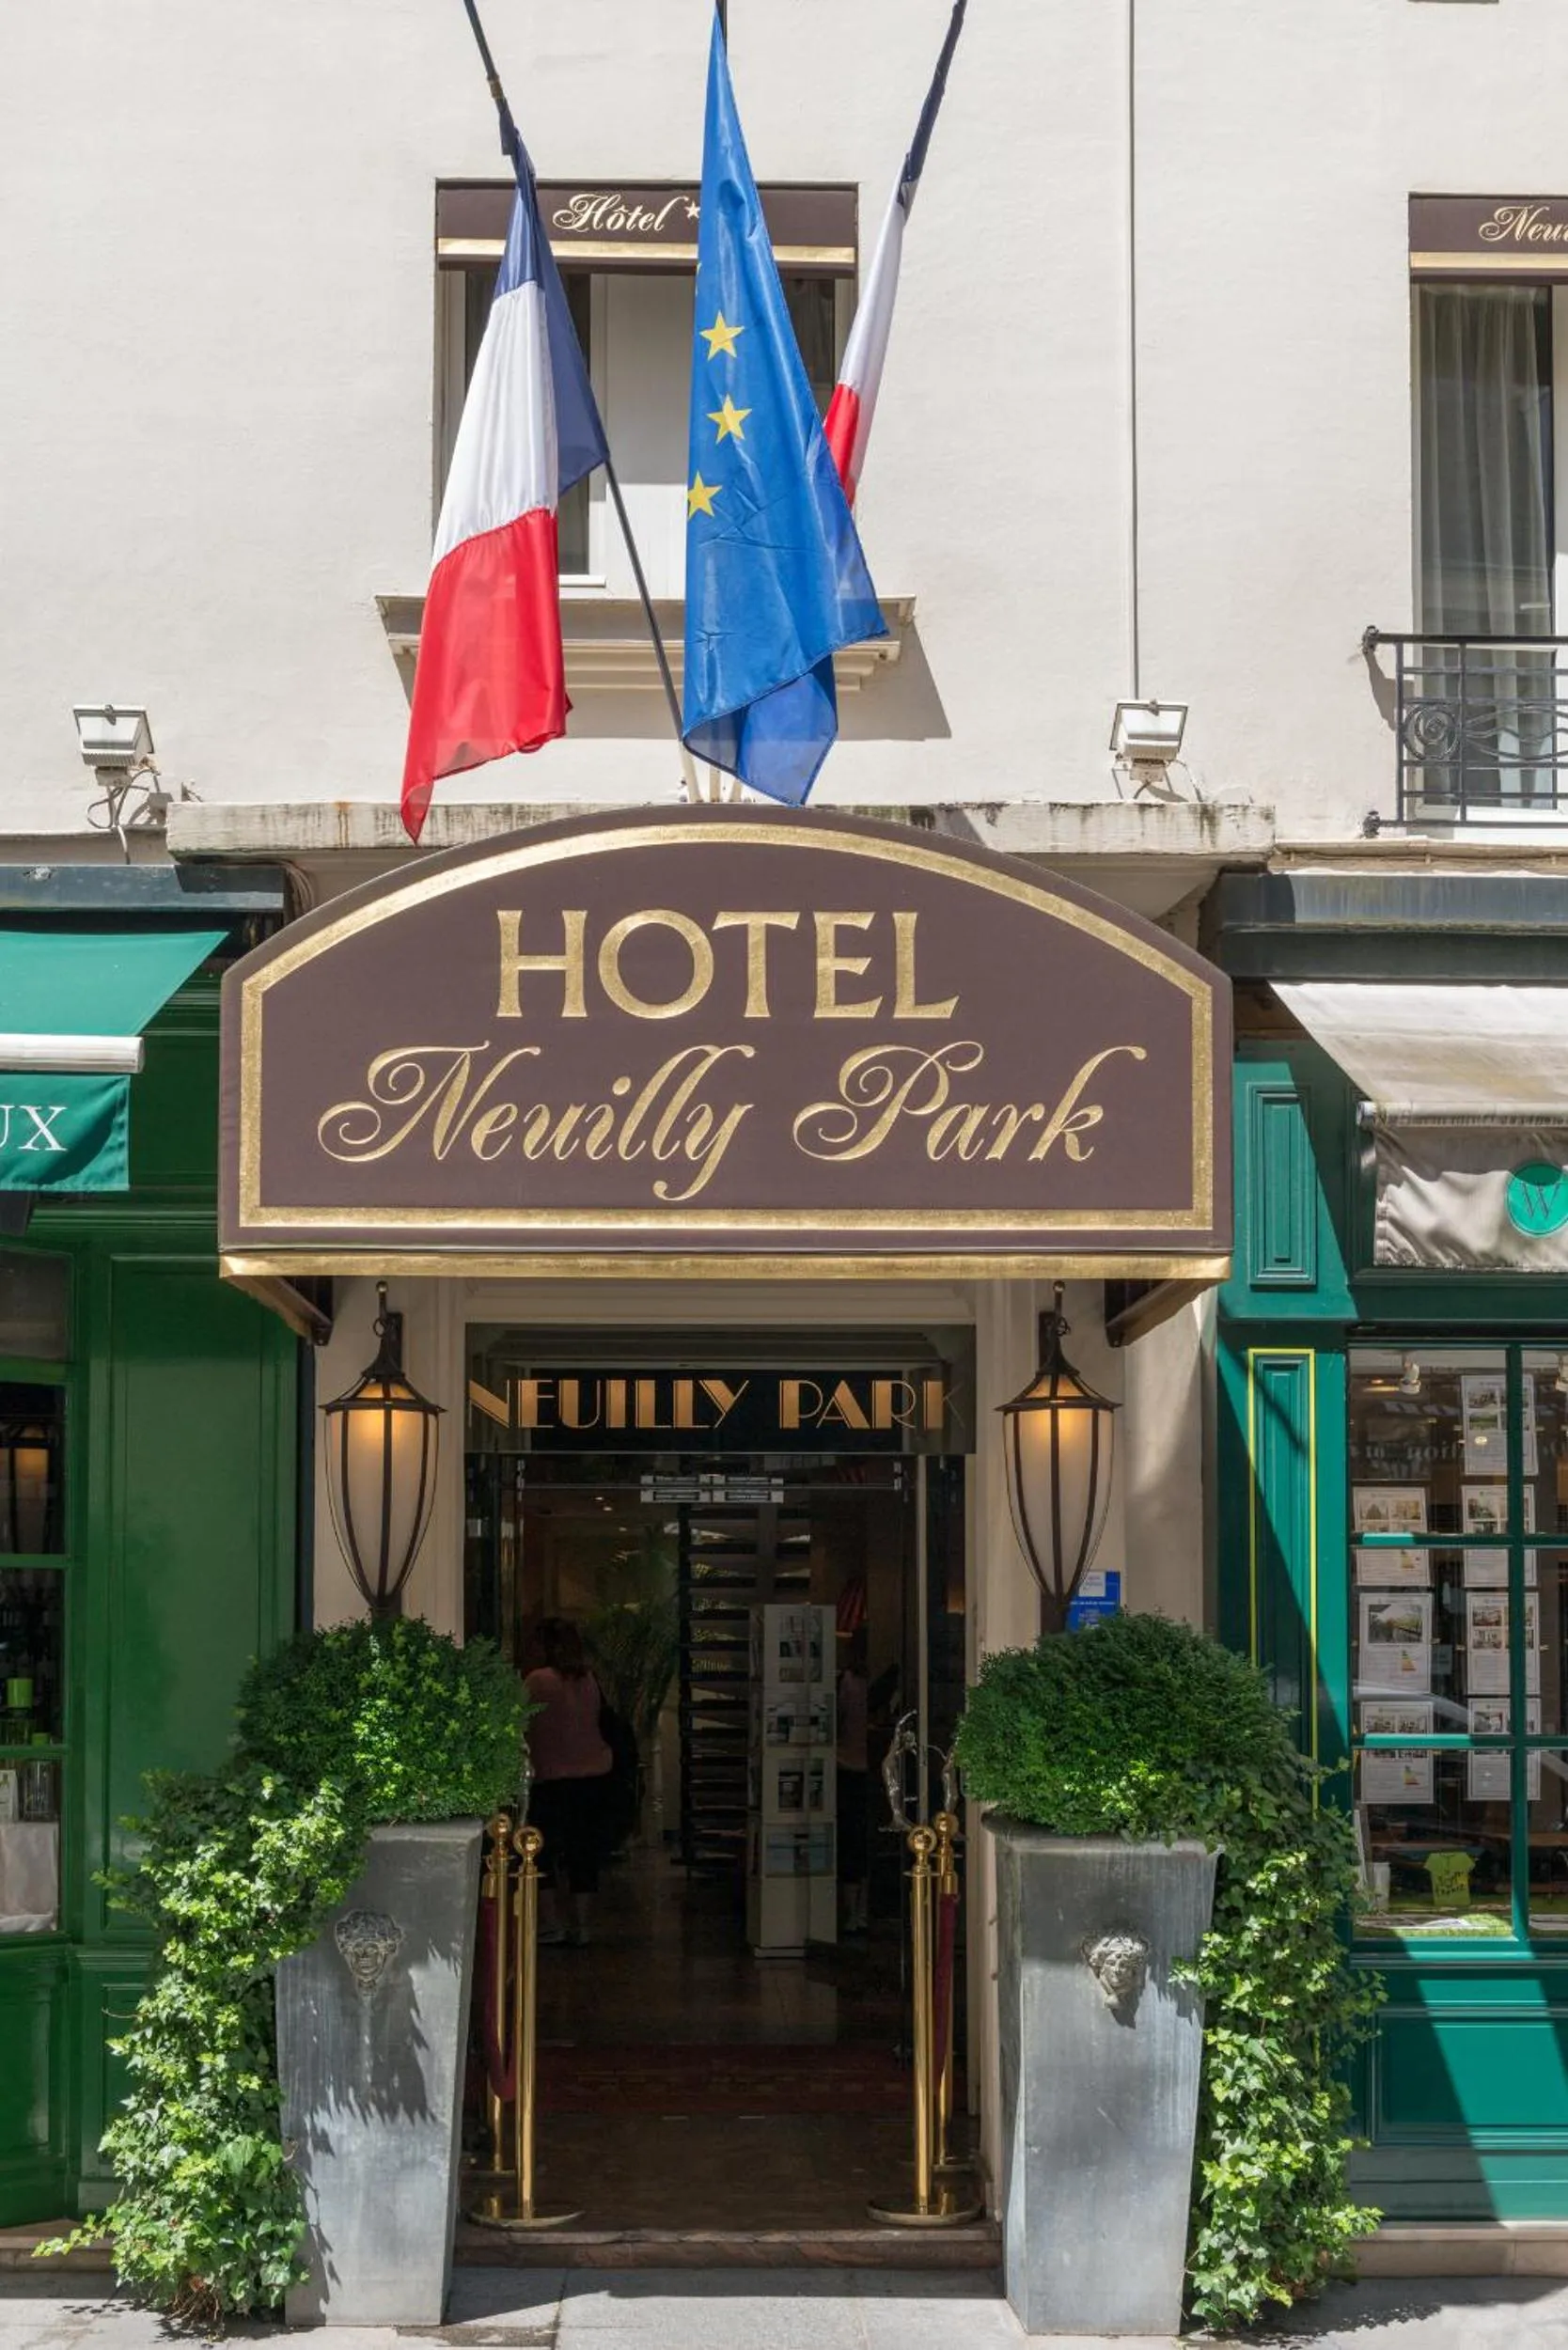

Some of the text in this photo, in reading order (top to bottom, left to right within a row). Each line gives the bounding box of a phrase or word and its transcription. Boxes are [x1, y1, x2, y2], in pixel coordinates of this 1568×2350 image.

[553, 193, 689, 233] Hôtel
[494, 906, 958, 1024] HOTEL
[316, 1040, 1149, 1202] Neuilly Park
[468, 1379, 966, 1430] NEUILLY PARK
